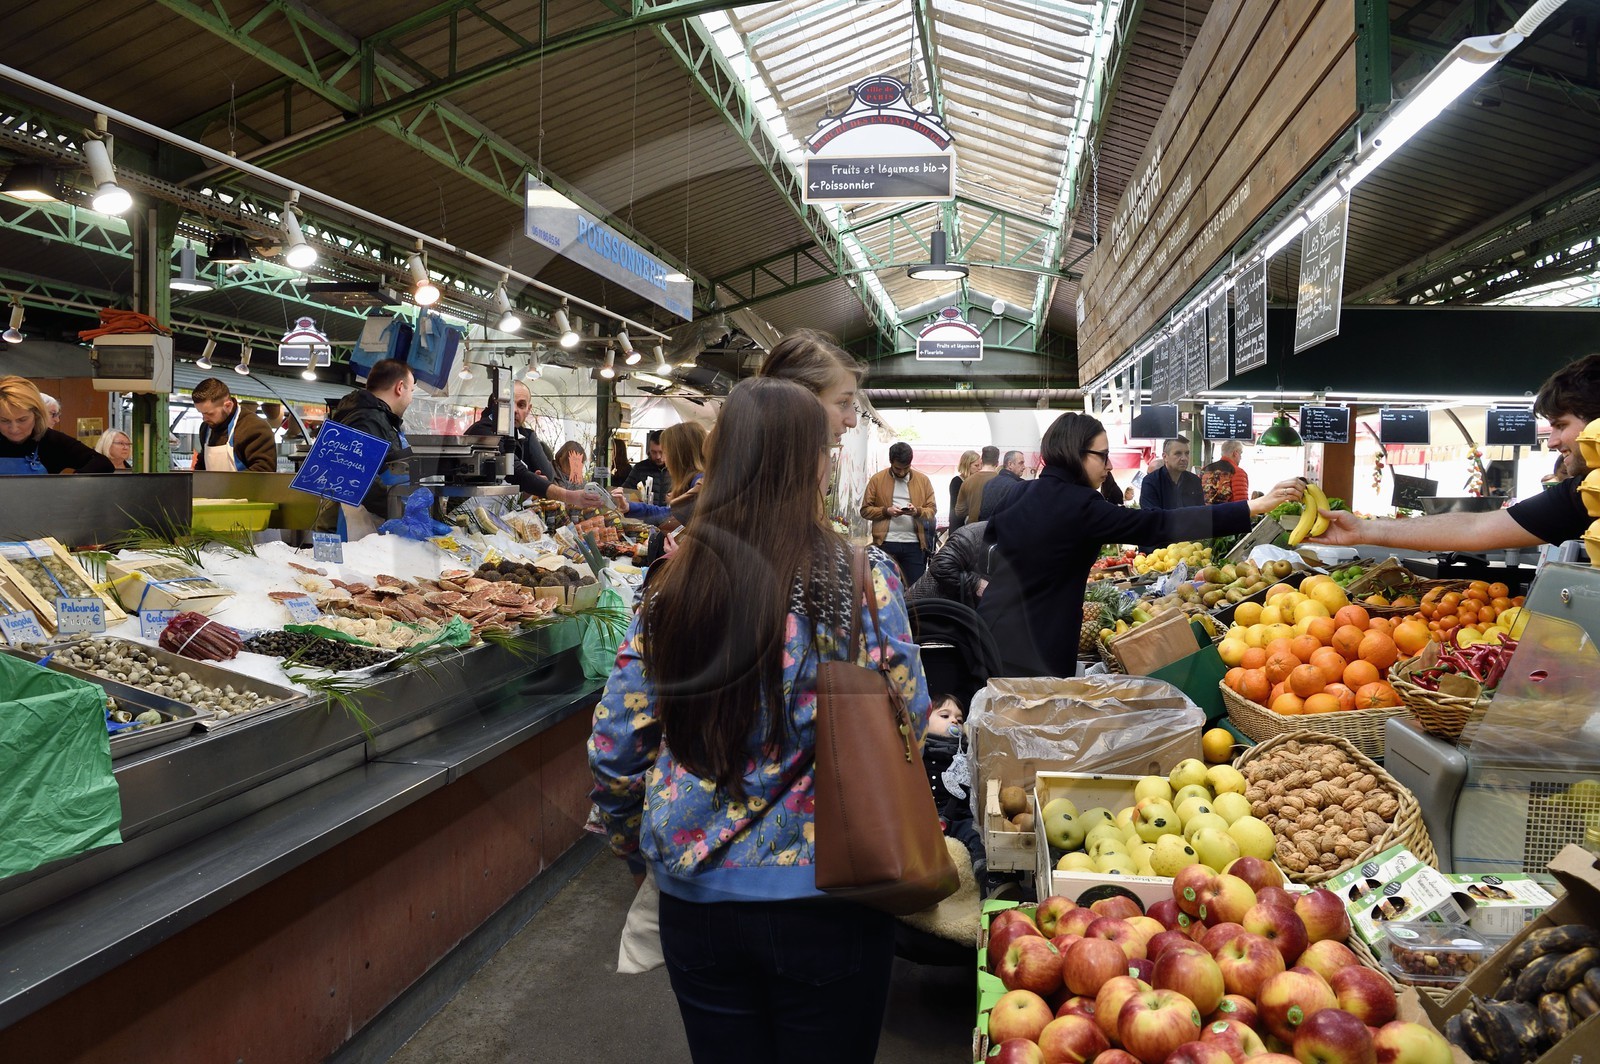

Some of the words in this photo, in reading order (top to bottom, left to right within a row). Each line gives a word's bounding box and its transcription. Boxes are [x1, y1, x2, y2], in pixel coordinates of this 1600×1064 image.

[850, 116, 869, 129] DES
[870, 115, 911, 127] ENFANTS
[912, 121, 946, 148] ROUGES
[831, 163, 861, 176] Fruits
[863, 164, 875, 175] et
[878, 163, 920, 178] légumes
[923, 162, 937, 174] bio
[820, 180, 876, 191] Poissonnier
[1173, 173, 1191, 213] Demeter
[1231, 193, 1239, 218] par
[1239, 175, 1251, 205] mail
[1111, 210, 1130, 263] Chez
[1127, 144, 1162, 235] Wagner
[576, 213, 668, 292] POISSONNERIE
[1155, 247, 1167, 271] Cheese
[957, 343, 975, 351] légumes
[322, 428, 364, 458] Coquilles
[330, 452, 366, 473] Jacques
[349, 479, 361, 488] €
[61, 602, 100, 613] Palourde
[3, 614, 33, 629] Vongole
